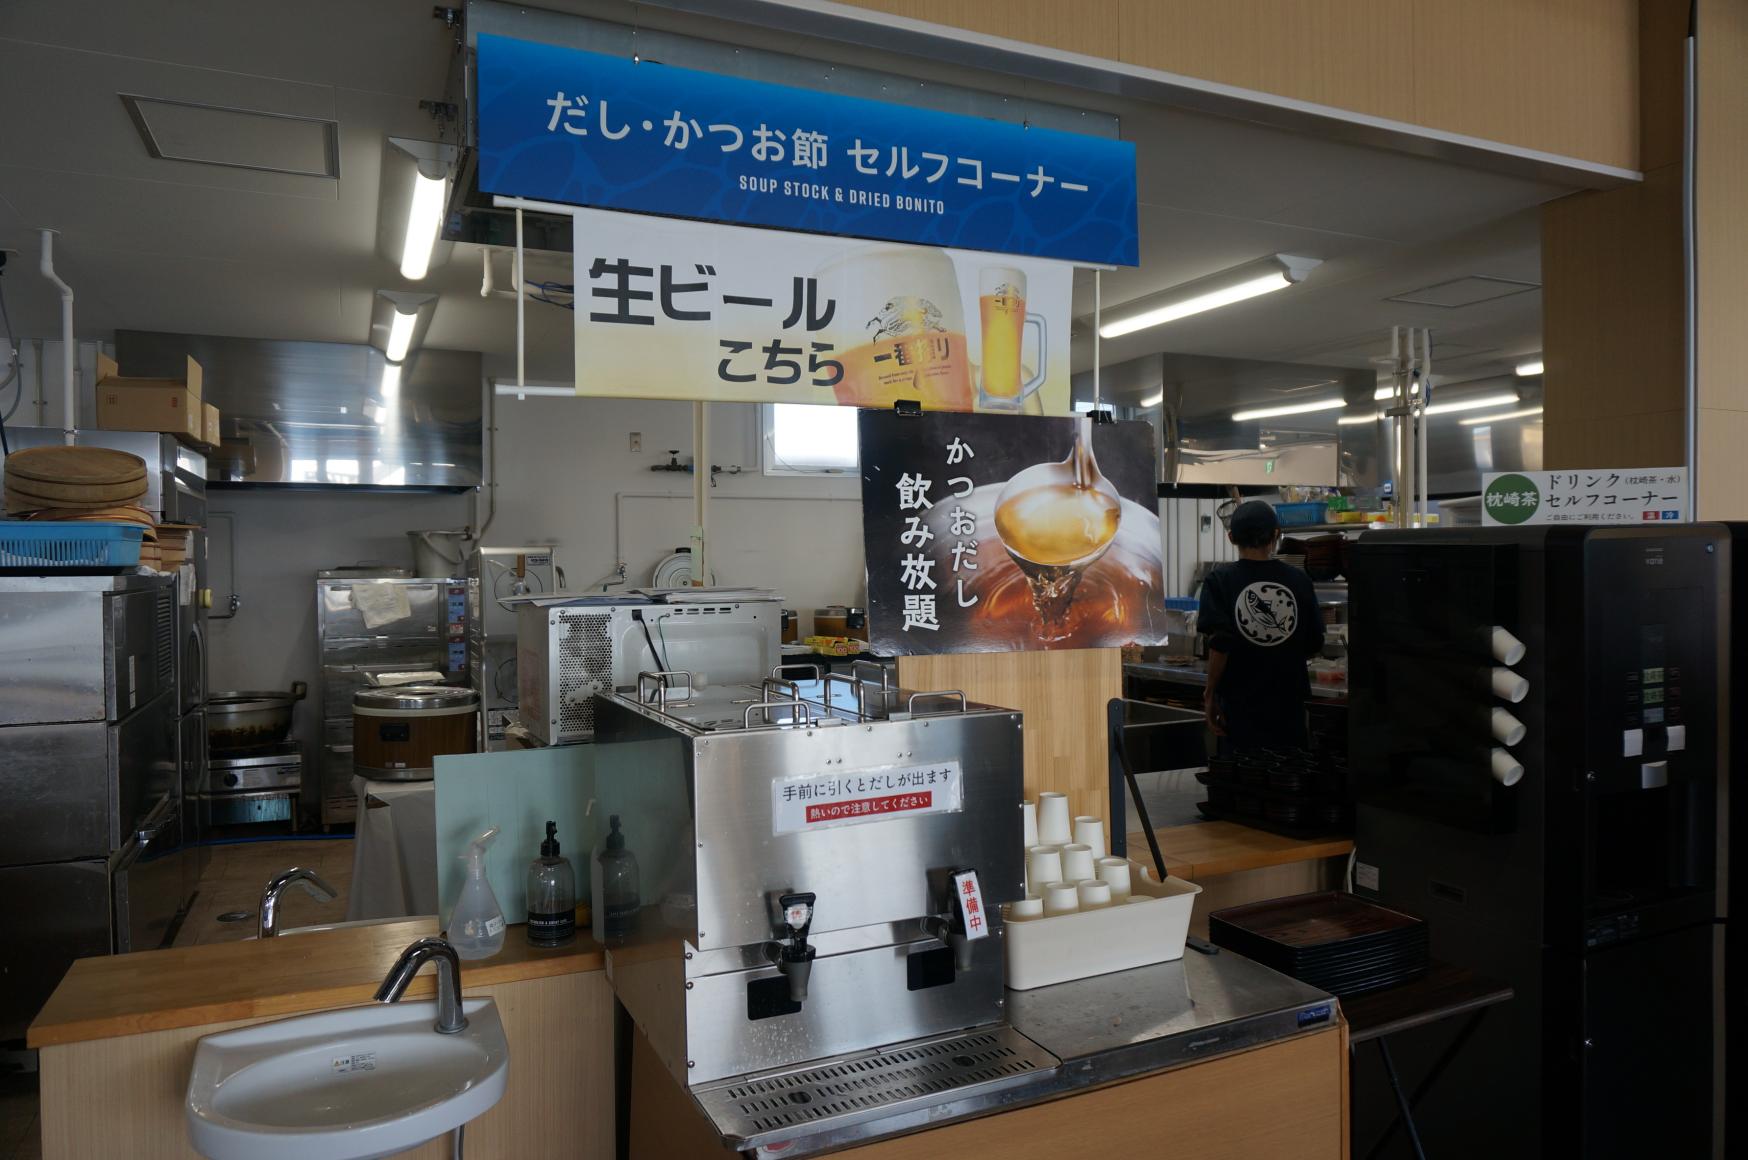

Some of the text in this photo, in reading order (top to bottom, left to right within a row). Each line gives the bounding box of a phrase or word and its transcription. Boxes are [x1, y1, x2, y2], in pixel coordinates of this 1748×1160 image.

[547, 91, 1088, 197] だし・かつお節 セルフコーナー
[739, 175, 944, 215] SOUP STOCK & DRIED BONITO
[589, 258, 836, 331] 生ビール
[718, 339, 844, 386] こちら
[1486, 491, 1538, 508] 枕崎茶
[1546, 491, 1678, 508] セルフコーナー
[1550, 474, 1621, 489] ドリンク
[946, 437, 979, 608] かつおだし
[896, 472, 940, 632] 飲み放題
[783, 768, 951, 801] 手前に引くとだしが出ます
[810, 796, 928, 820] 熱いので注意してください
[962, 880, 981, 931] 準備中
